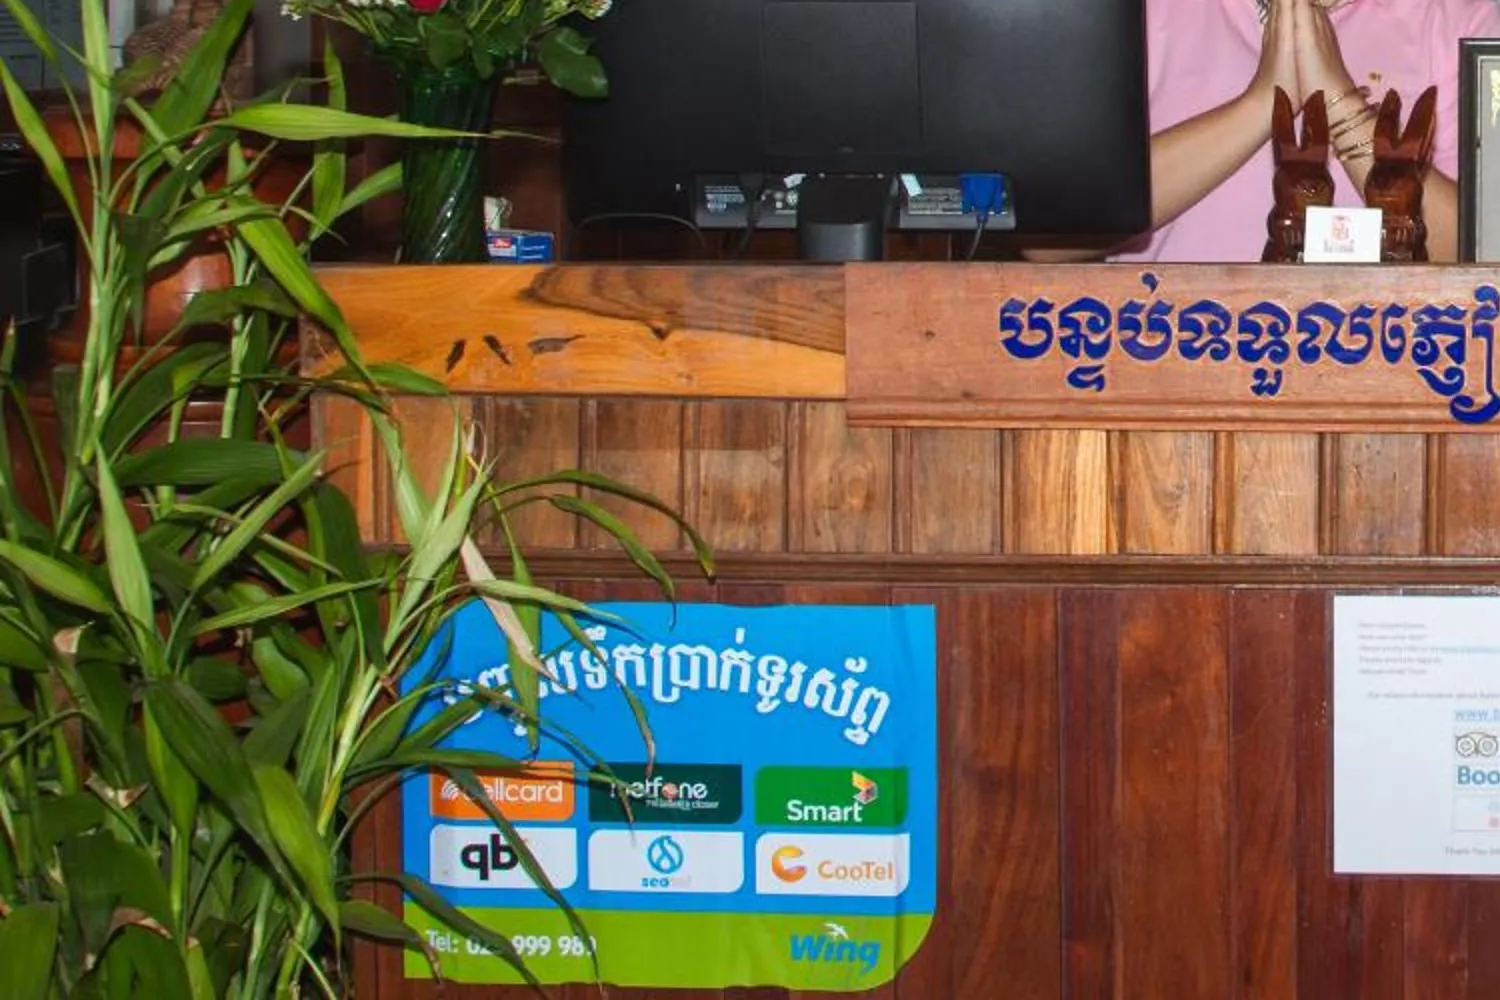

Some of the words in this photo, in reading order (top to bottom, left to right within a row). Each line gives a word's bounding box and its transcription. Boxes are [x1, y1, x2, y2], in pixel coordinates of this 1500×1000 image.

[786, 800, 863, 823] Smart
[816, 859, 895, 882] CooTel
[425, 928, 459, 953] Tel:
[511, 935, 552, 956] 999
[789, 933, 882, 975] Wing
